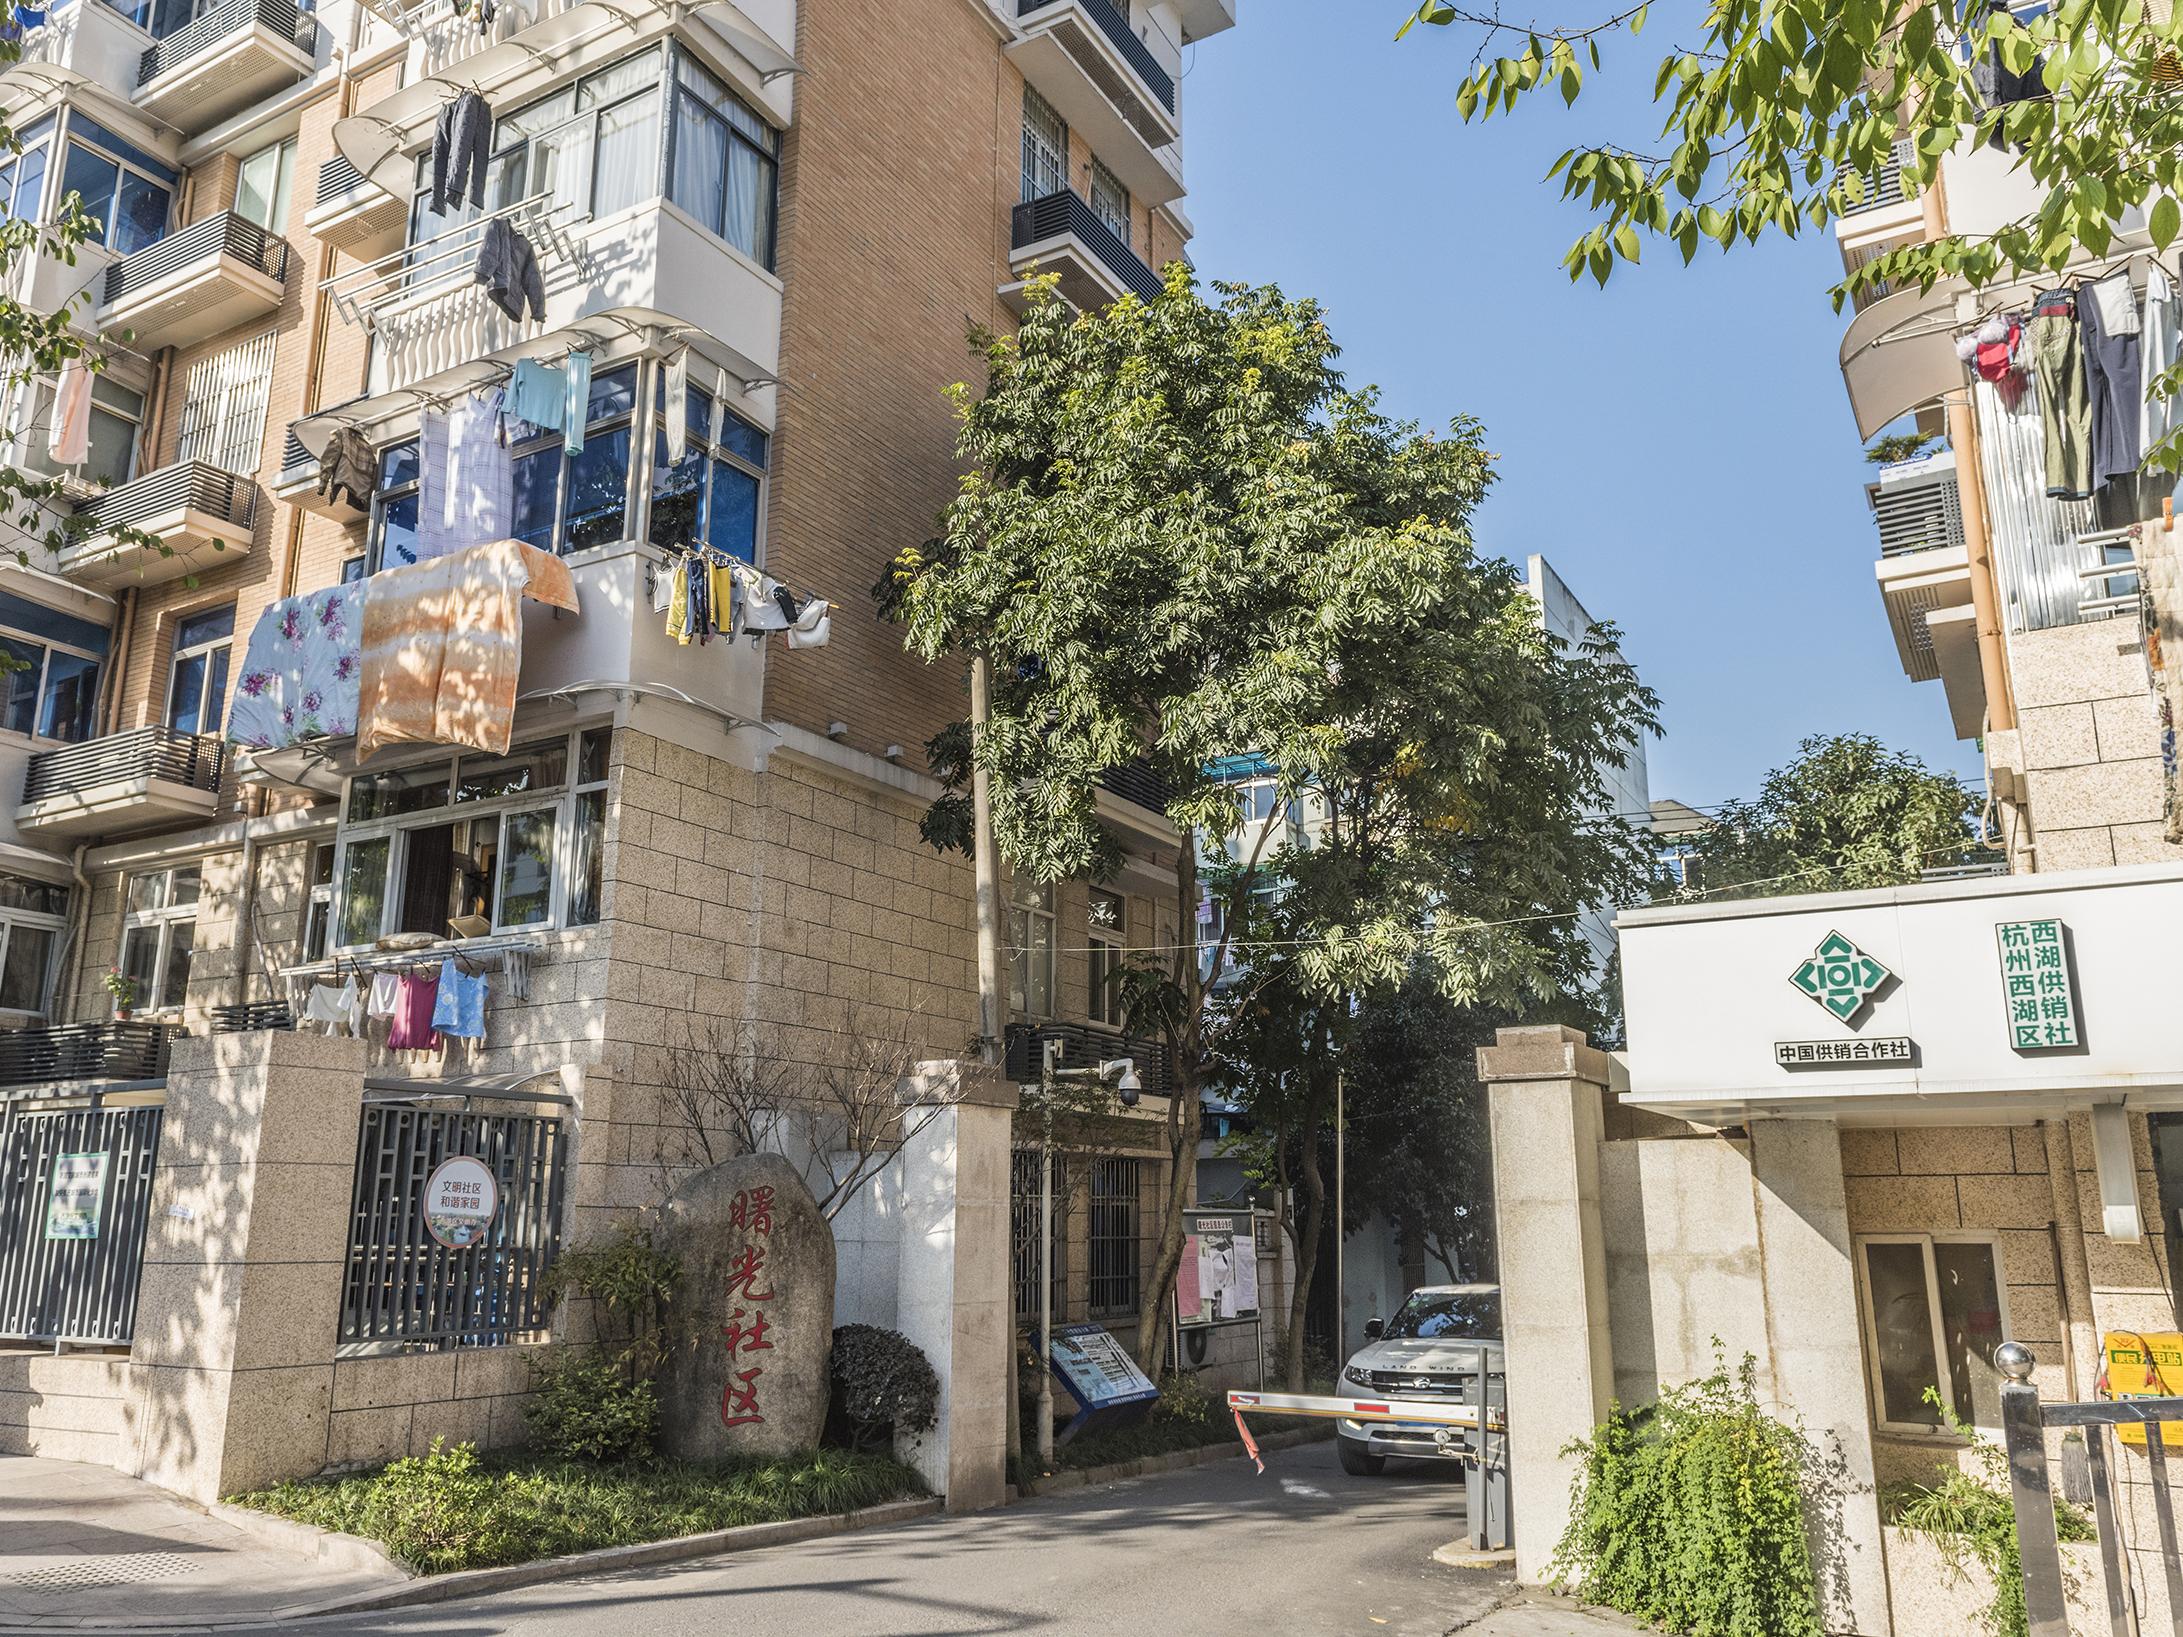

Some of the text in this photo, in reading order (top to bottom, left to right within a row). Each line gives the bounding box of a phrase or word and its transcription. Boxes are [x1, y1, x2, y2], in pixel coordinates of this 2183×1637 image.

[2001, 924, 2043, 1047] 杭州西湖区
[2030, 921, 2073, 1045] 西湖供销社
[1779, 1040, 1909, 1061] 中国供销合作社
[440, 1195, 480, 1209] 和谐家园
[441, 1180, 482, 1194] 文明社区
[722, 1185, 775, 1427] 曙光社区
